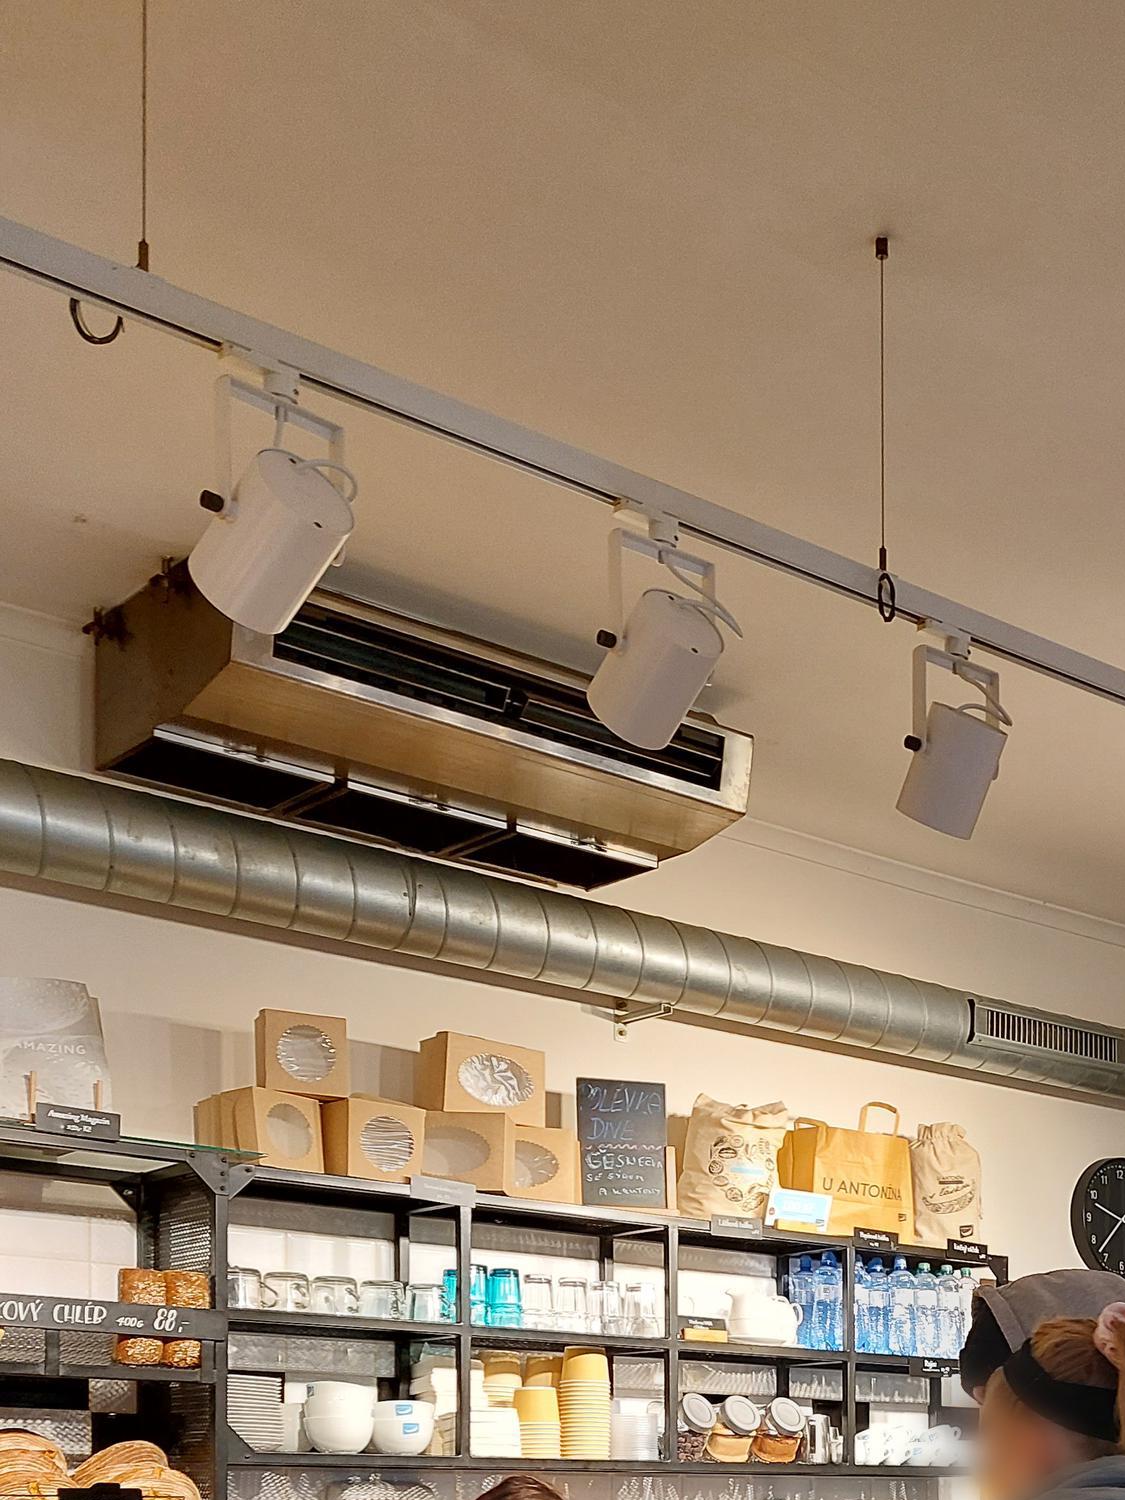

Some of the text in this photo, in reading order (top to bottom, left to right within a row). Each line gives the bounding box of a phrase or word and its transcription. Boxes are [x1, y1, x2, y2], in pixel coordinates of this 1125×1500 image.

[1116, 1170, 1124, 1179] 12
[822, 1177, 833, 1190] U
[1101, 1175, 1108, 1184] 11
[1090, 1190, 1098, 1199] 10
[1086, 1212, 1092, 1222] 9
[1091, 1234, 1097, 1244] 8
[1103, 1253, 1108, 1262] 7
[1119, 1261, 1124, 1270] 6
[0, 1300, 43, 1322] OVÝ
[53, 1301, 107, 1325] CHLÉB
